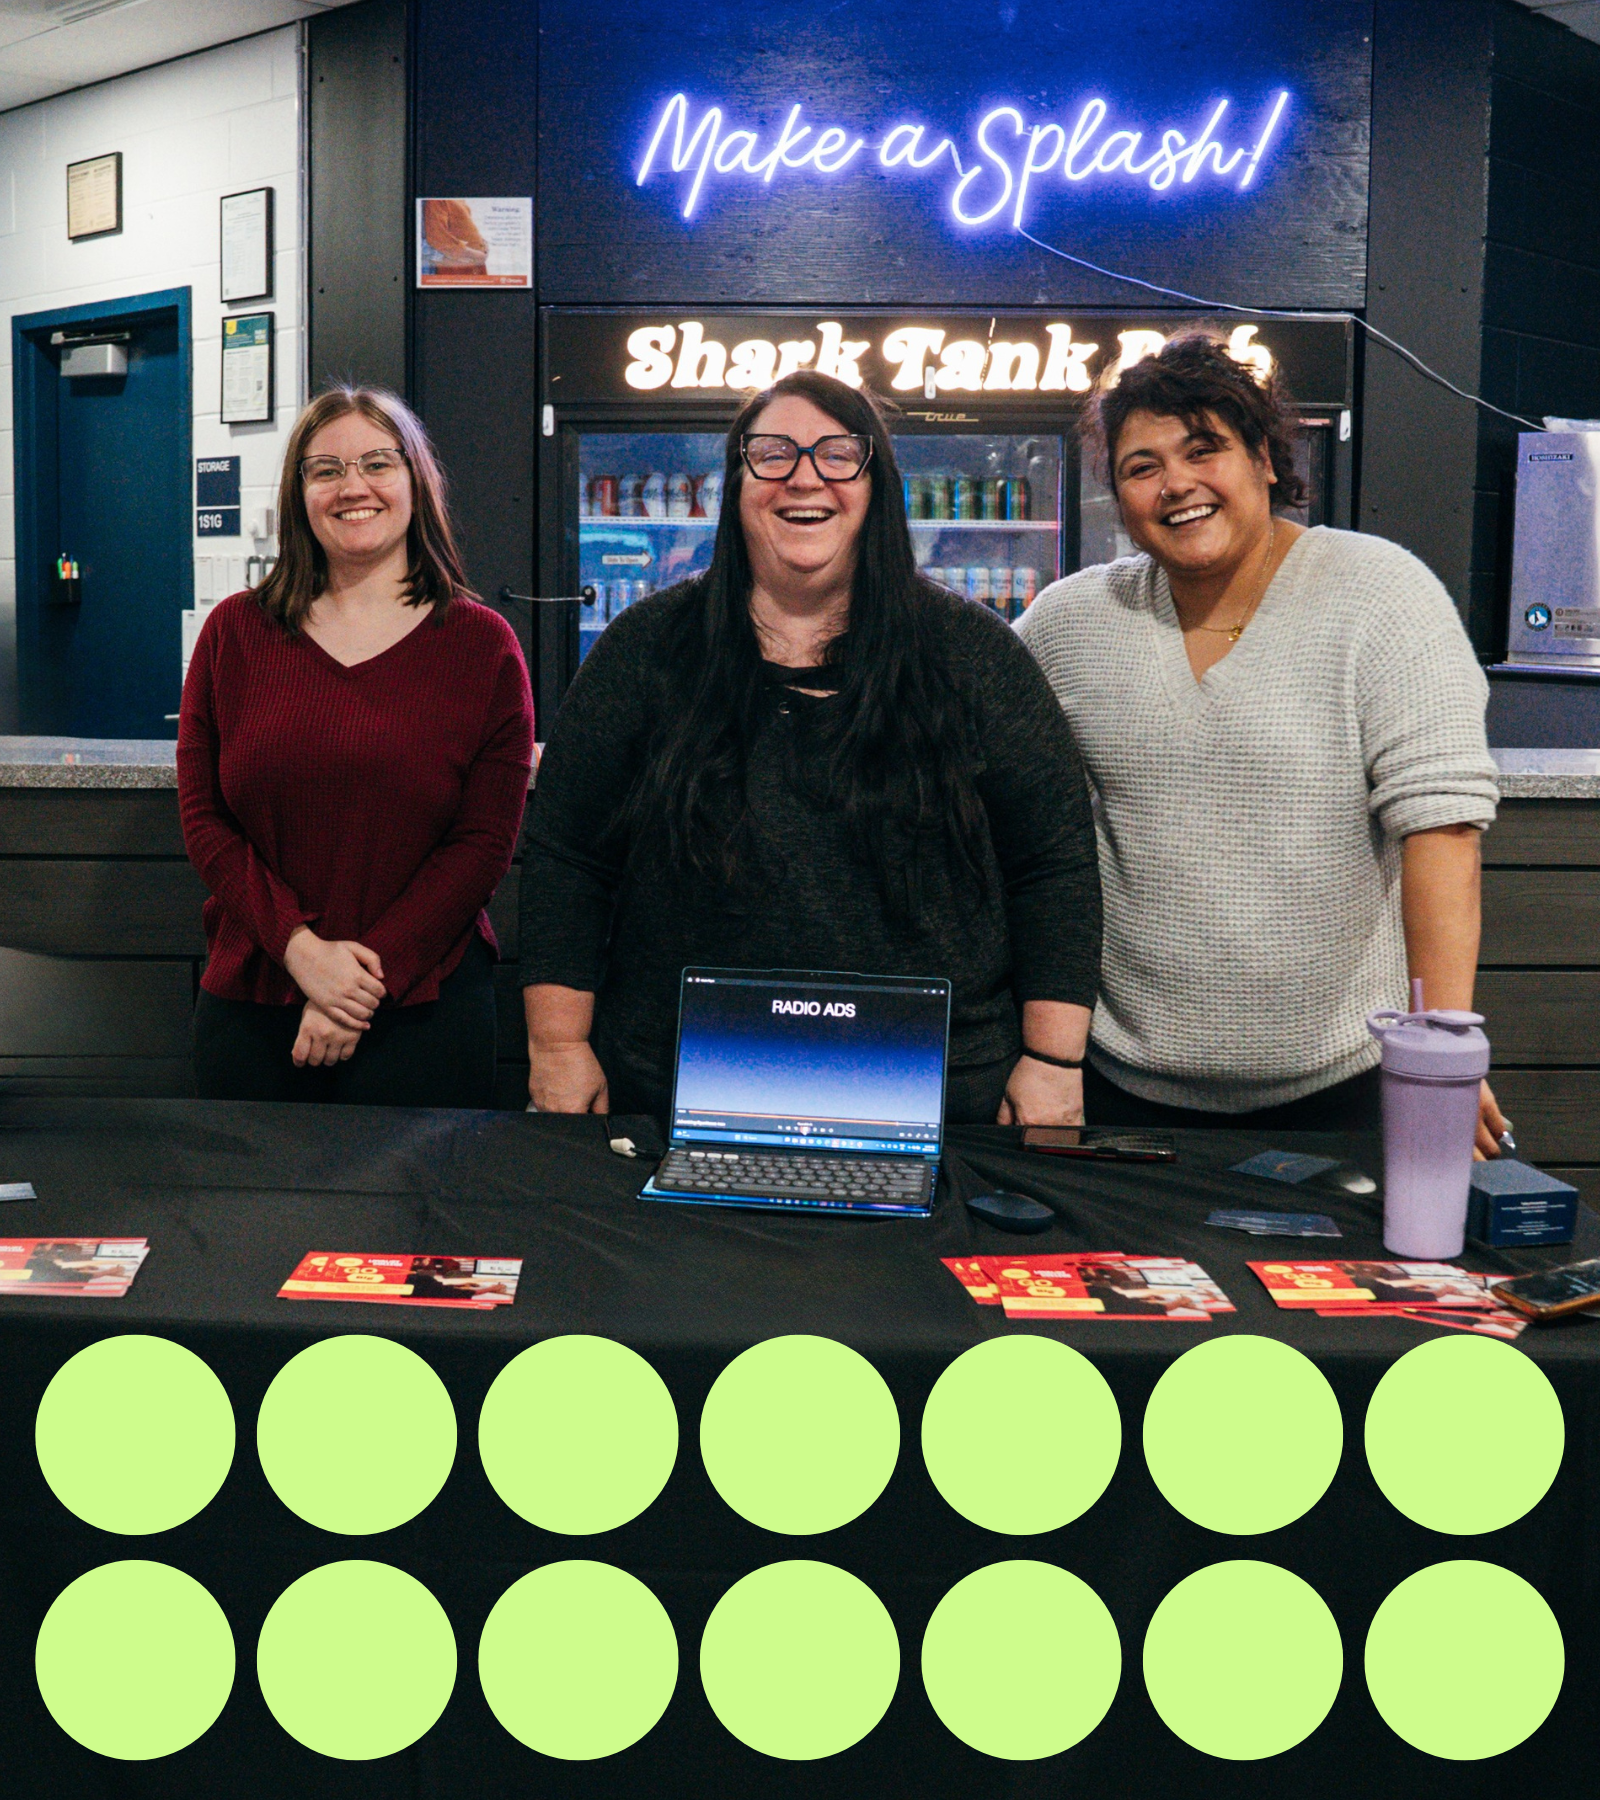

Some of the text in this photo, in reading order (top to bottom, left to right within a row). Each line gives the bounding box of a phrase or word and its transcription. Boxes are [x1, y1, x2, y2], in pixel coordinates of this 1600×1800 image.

[636, 91, 1290, 230] Make a Splash!
[625, 321, 1273, 392] Shark Tank Pb
[907, 412, 978, 422] true
[198, 460, 230, 474] STORAGE
[198, 514, 222, 529] 1S1G
[772, 1000, 856, 1018] RADIO ADS
